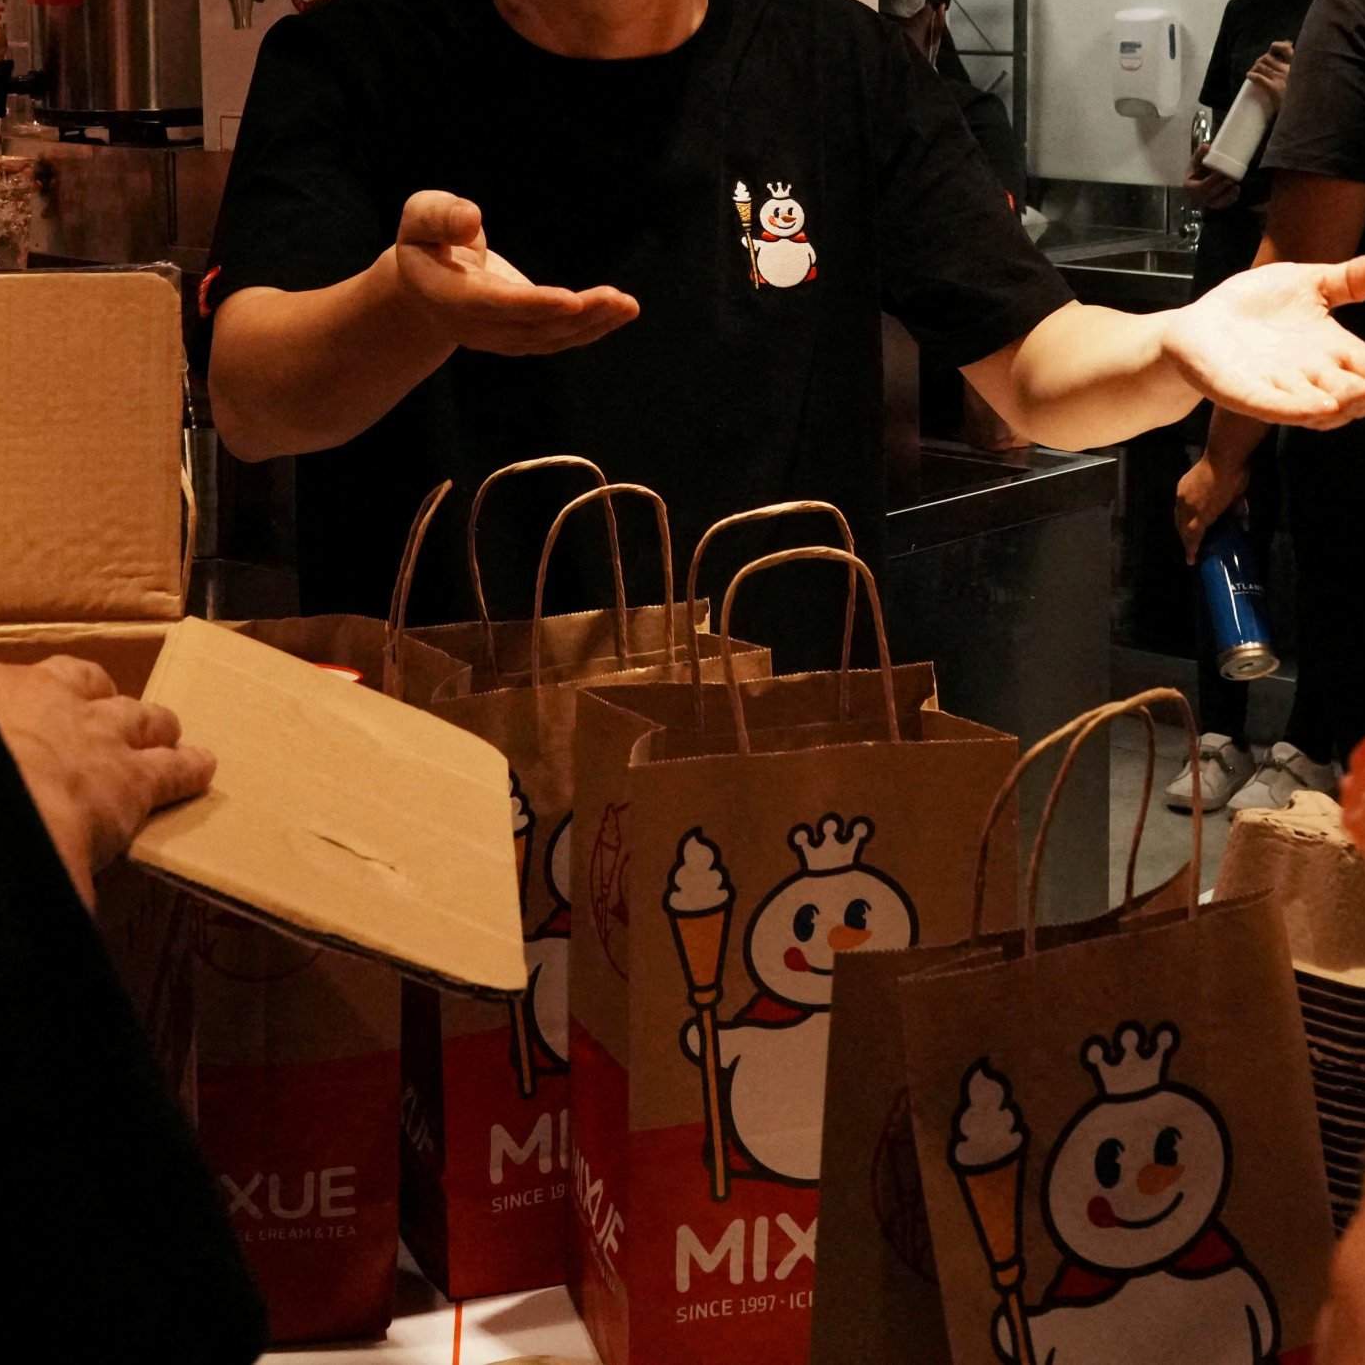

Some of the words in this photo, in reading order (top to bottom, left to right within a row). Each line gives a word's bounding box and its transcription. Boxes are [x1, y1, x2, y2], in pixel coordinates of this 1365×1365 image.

[491, 1188, 544, 1213] SINCE
[259, 1227, 311, 1241] CREAM
[327, 1225, 356, 1238] TEA
[676, 1299, 733, 1323] SINCE
[740, 1294, 777, 1314] 1997
